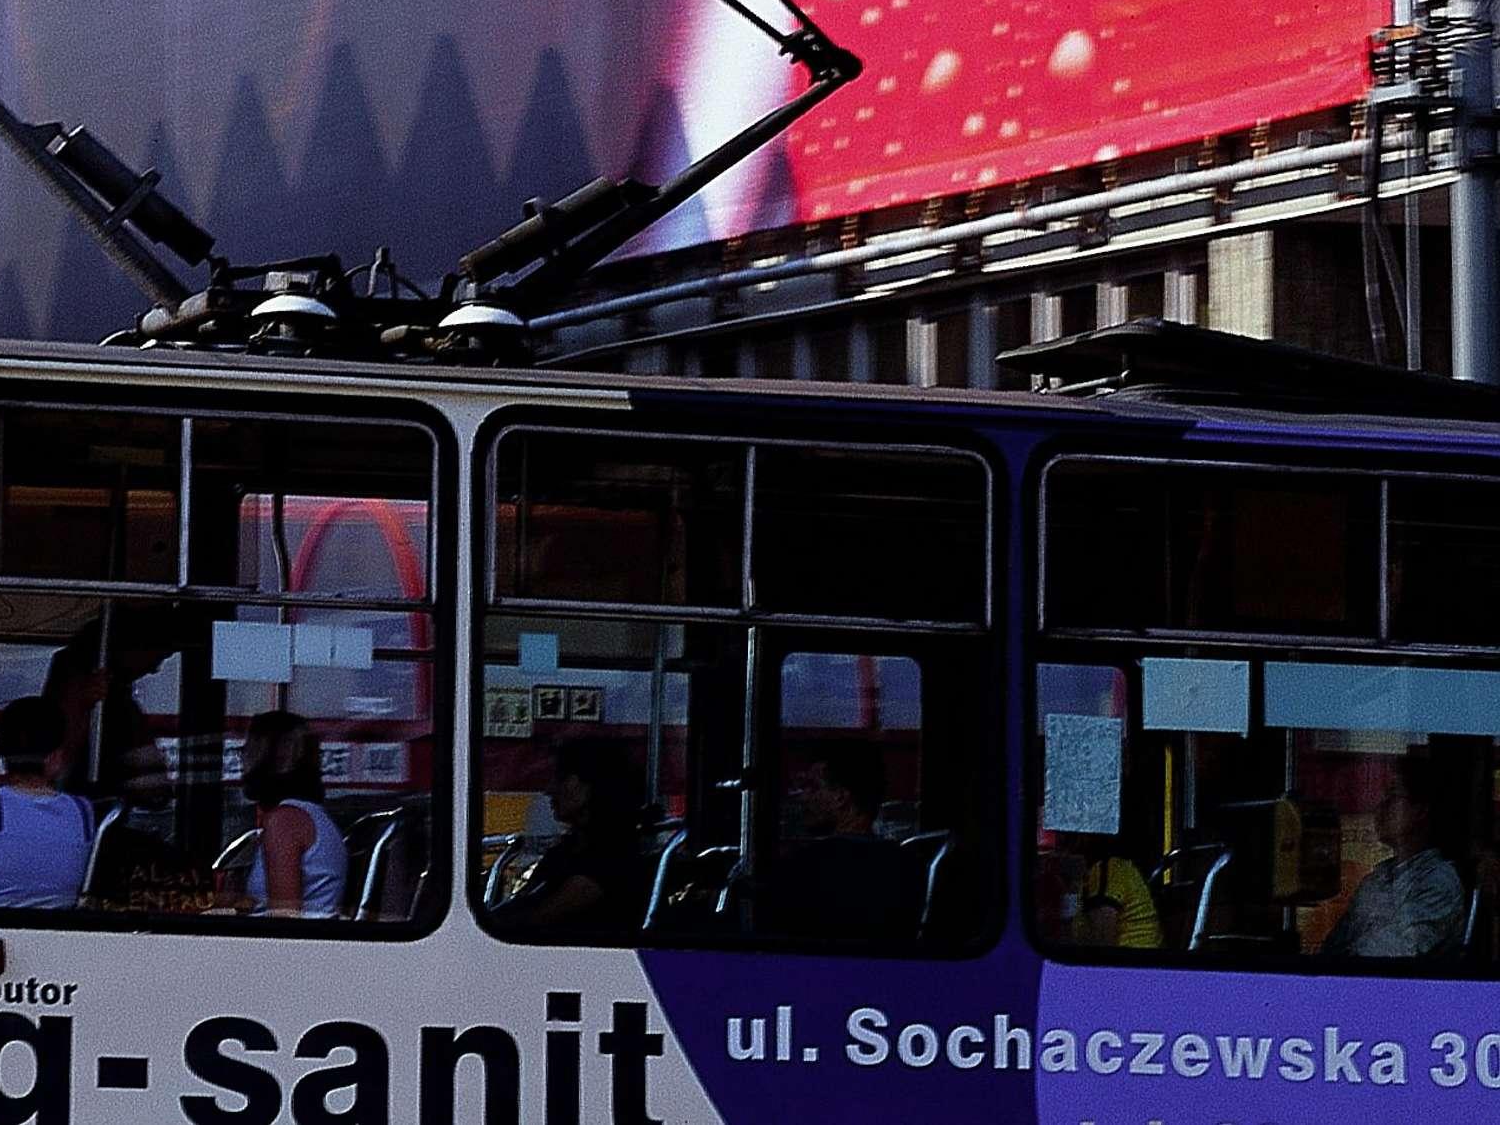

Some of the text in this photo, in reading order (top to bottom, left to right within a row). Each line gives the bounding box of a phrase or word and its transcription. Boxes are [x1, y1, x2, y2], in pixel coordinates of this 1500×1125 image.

[725, 1006, 1500, 1088] ul. Sochaczewska 30
